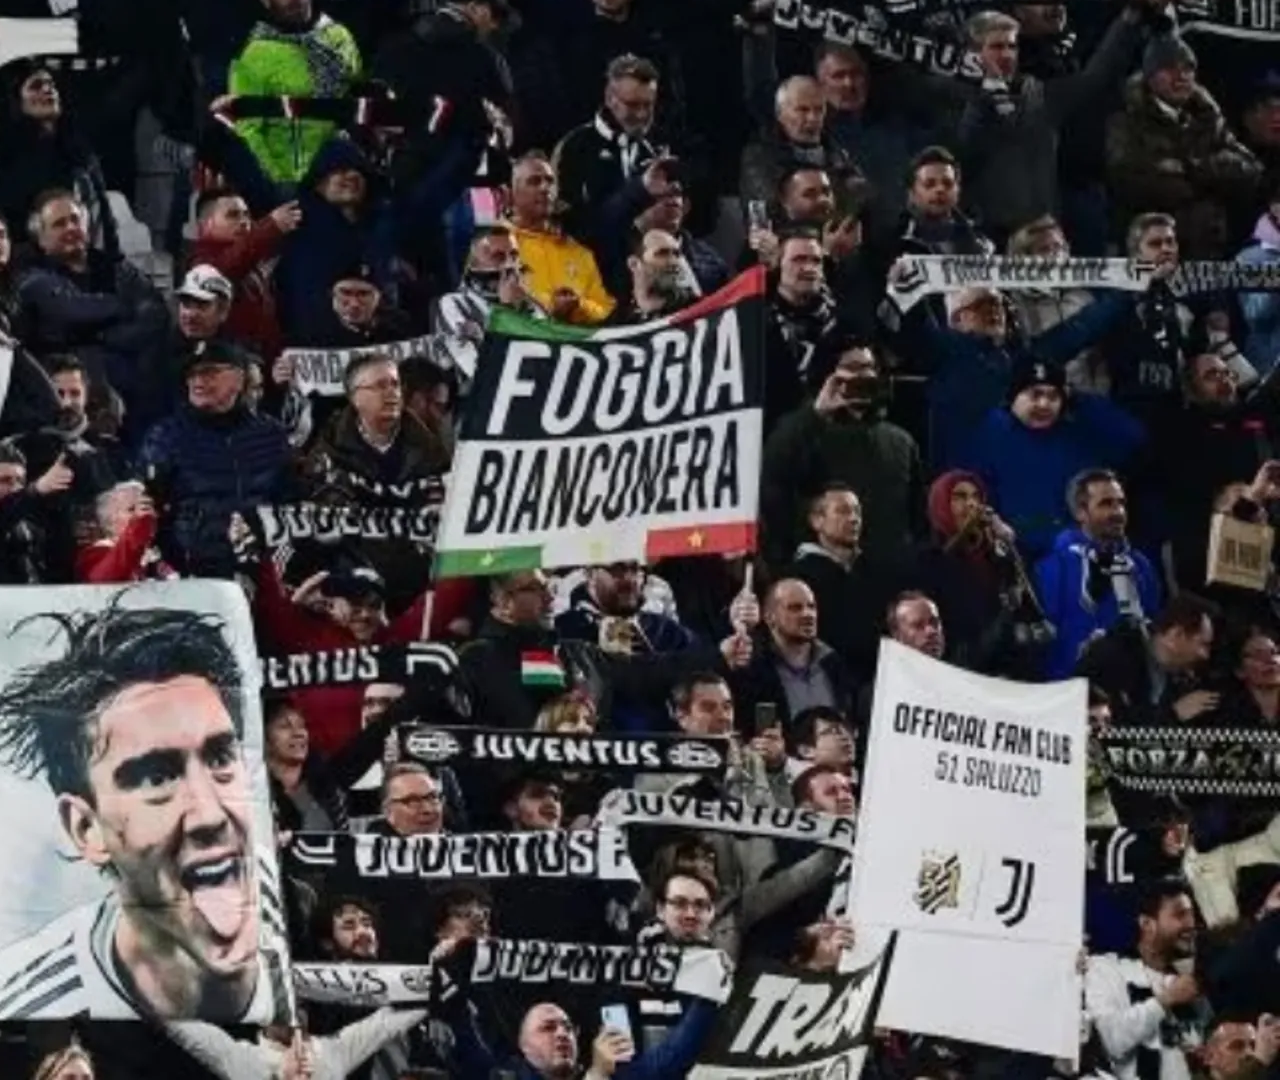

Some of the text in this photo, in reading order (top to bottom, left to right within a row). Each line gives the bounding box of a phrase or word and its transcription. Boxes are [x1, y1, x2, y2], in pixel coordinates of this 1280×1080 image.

[486, 308, 745, 435] FOGGIA
[464, 421, 739, 536] BIANCONERA
[260, 504, 440, 542] JUVENTU
[471, 738, 662, 767] JUVENTUS
[893, 702, 989, 743] OFFICIAL
[1037, 731, 1074, 765] CLUB
[936, 753, 1042, 797] 51 SALUZZO
[621, 791, 818, 833] JUVENTUS
[354, 832, 600, 878] JUVENTUS
